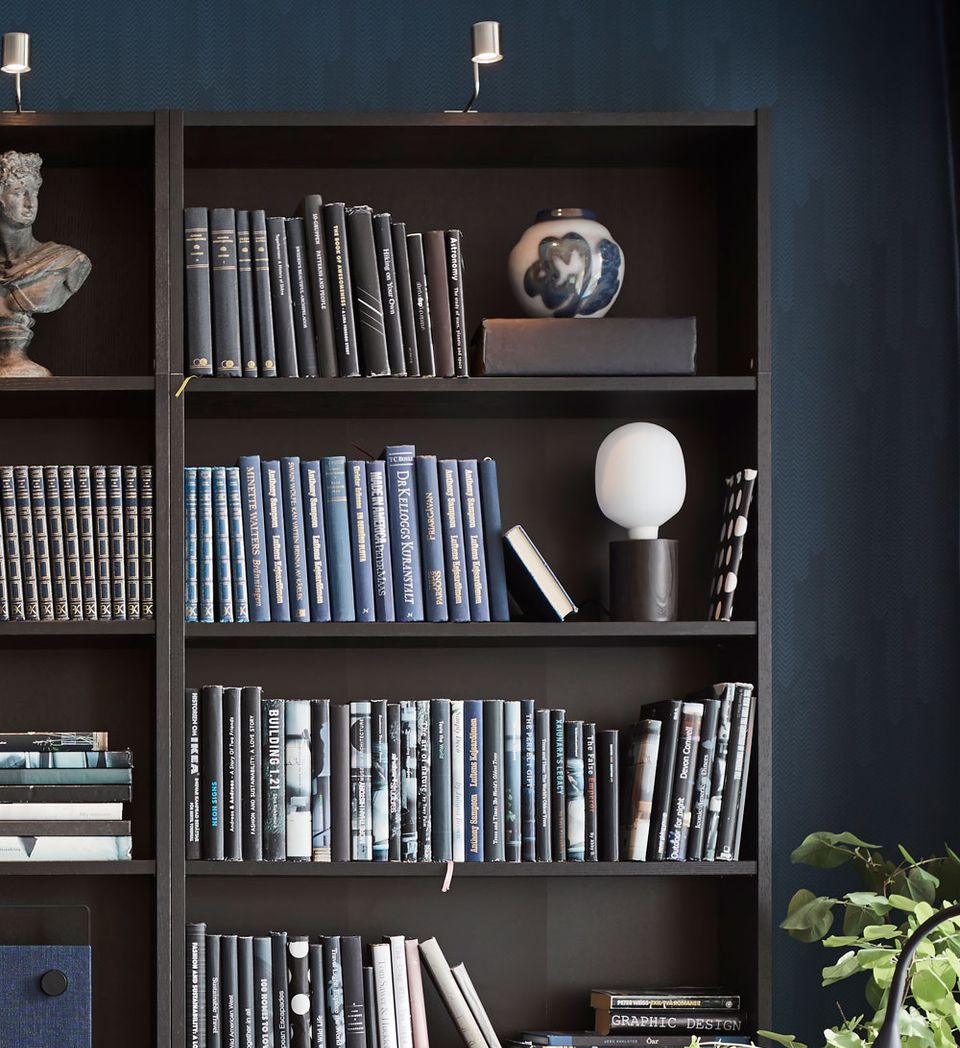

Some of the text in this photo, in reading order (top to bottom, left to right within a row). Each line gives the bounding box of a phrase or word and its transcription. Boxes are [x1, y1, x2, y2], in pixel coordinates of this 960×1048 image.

[336, 255, 343, 263] OF
[449, 237, 459, 280] Astronomy
[336, 264, 346, 306] AWESOMENESS
[308, 469, 319, 497] Anthony
[246, 467, 260, 555] MINETTE WALTERS
[310, 498, 319, 528] Sampson
[400, 542, 415, 604] KURANSTALT
[191, 692, 199, 724] HISTORIEN
[191, 725, 198, 736] OM
[670, 726, 693, 860] Outdoor for night Devon Cornwell
[278, 990, 286, 1029] Escapades
[612, 1015, 742, 1031] GRAPHIC DESIGN
